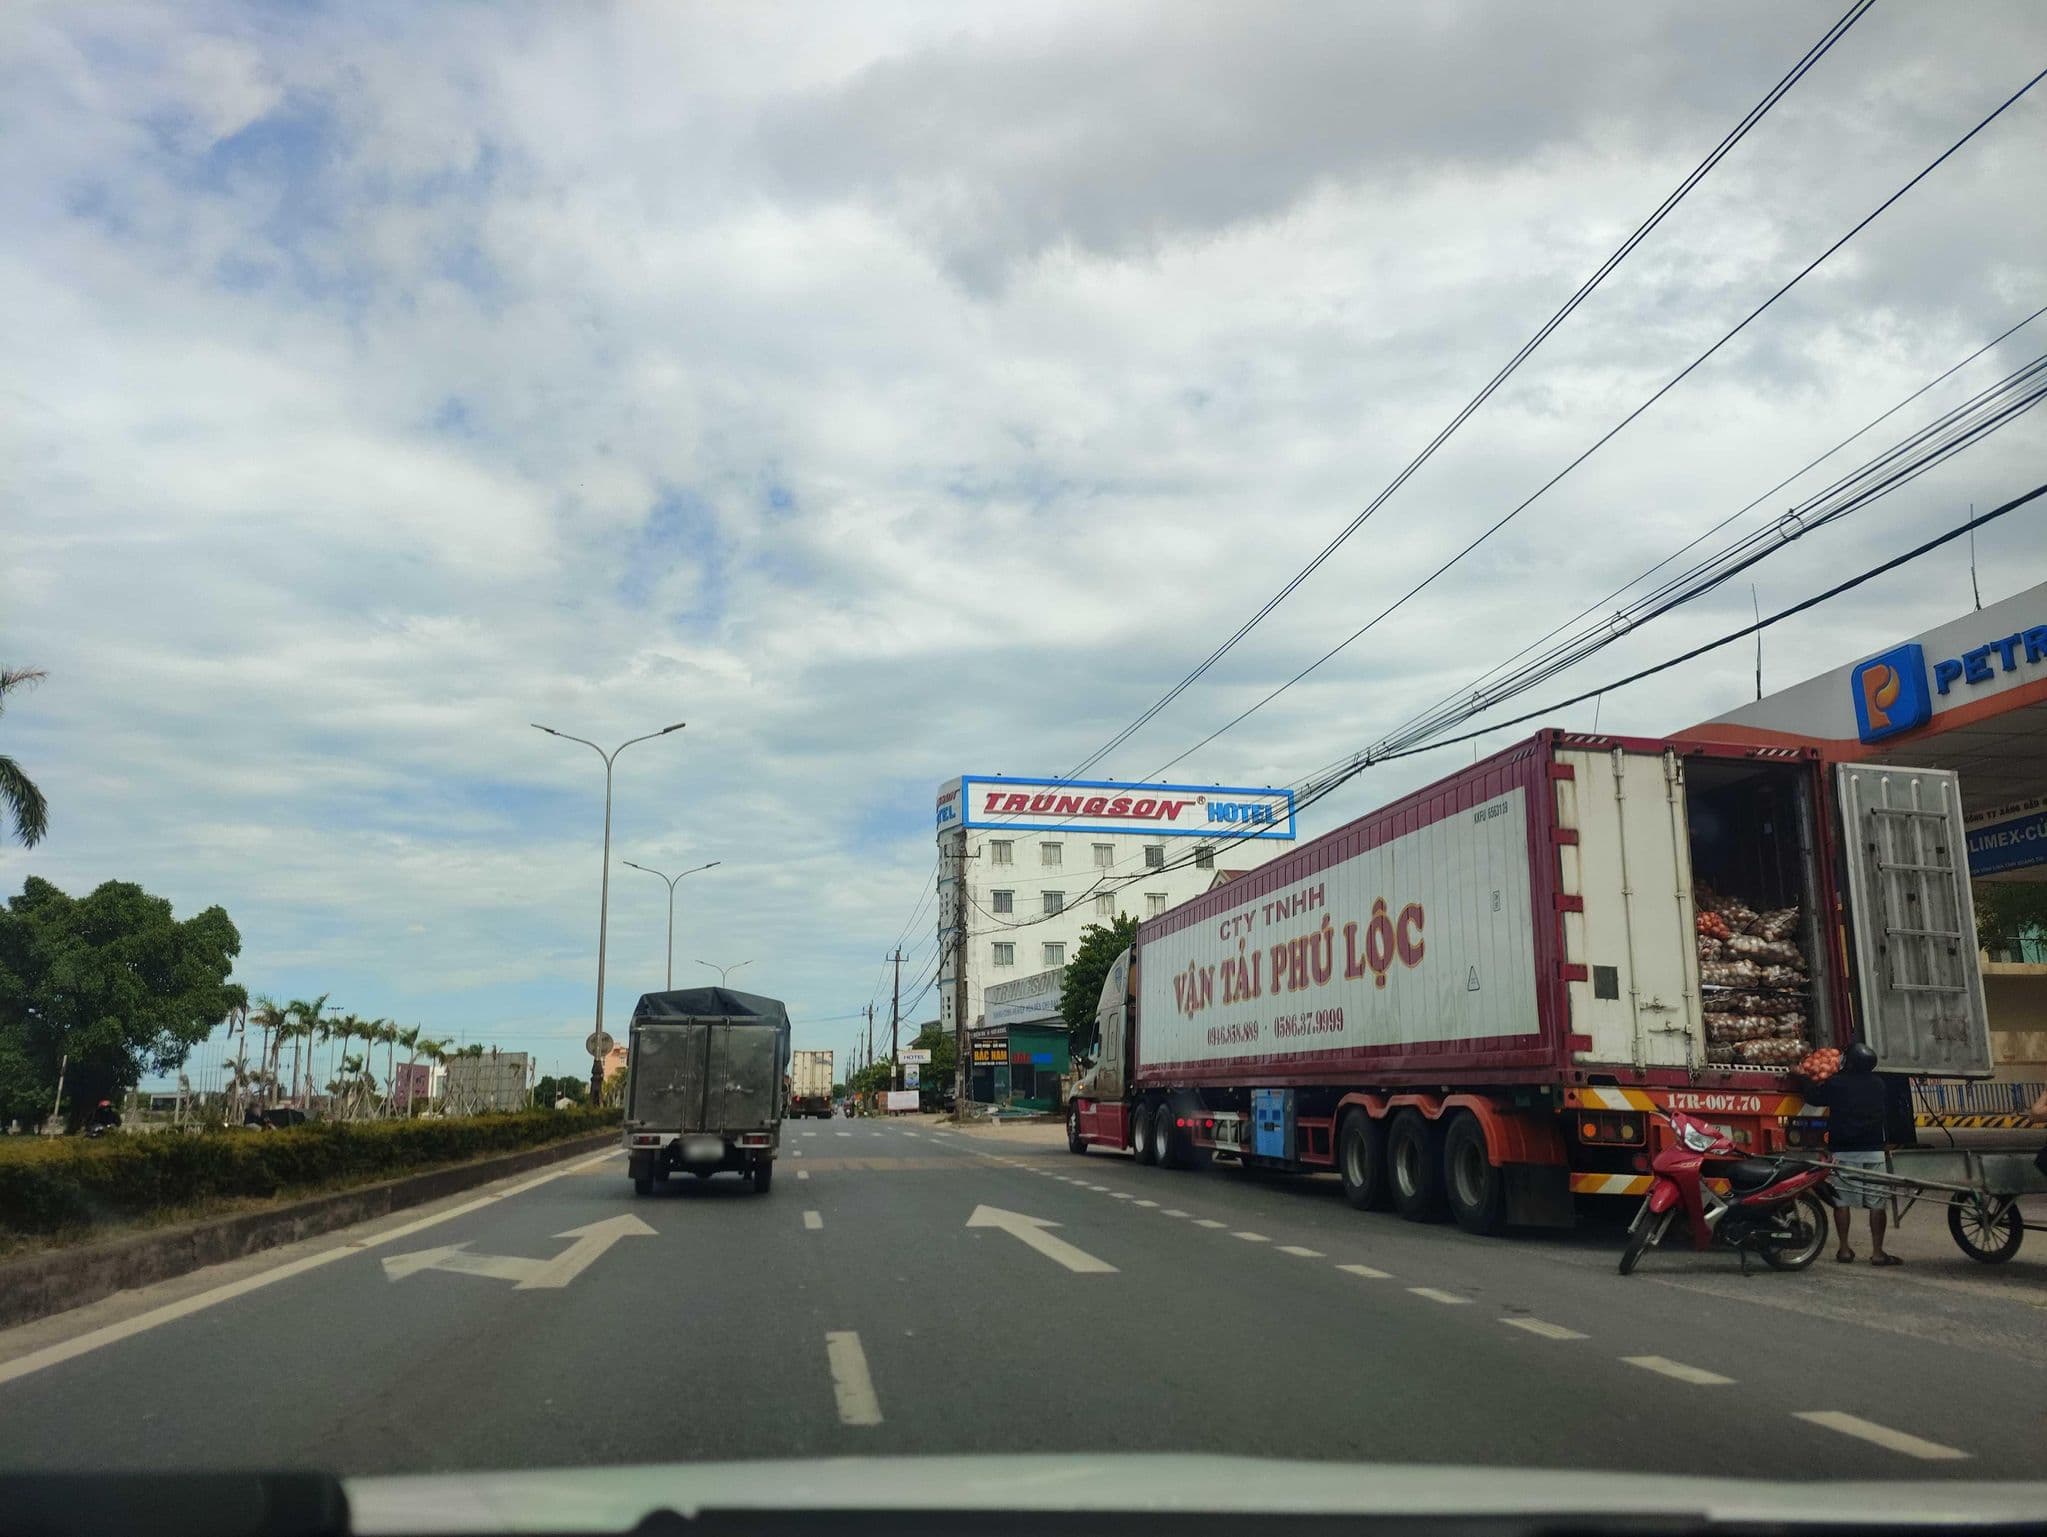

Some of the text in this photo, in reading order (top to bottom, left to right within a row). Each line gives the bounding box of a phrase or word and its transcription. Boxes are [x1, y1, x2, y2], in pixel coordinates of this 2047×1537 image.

[1208, 801, 1278, 825] HOTEL
[1219, 882, 1325, 941] CTY TNHH
[1173, 896, 1426, 1020] VẬN TẢI PHÚ LỘC
[1274, 1006, 1344, 1039] 0586.37.9999
[1667, 1093, 1761, 1113] 17R-007.70
